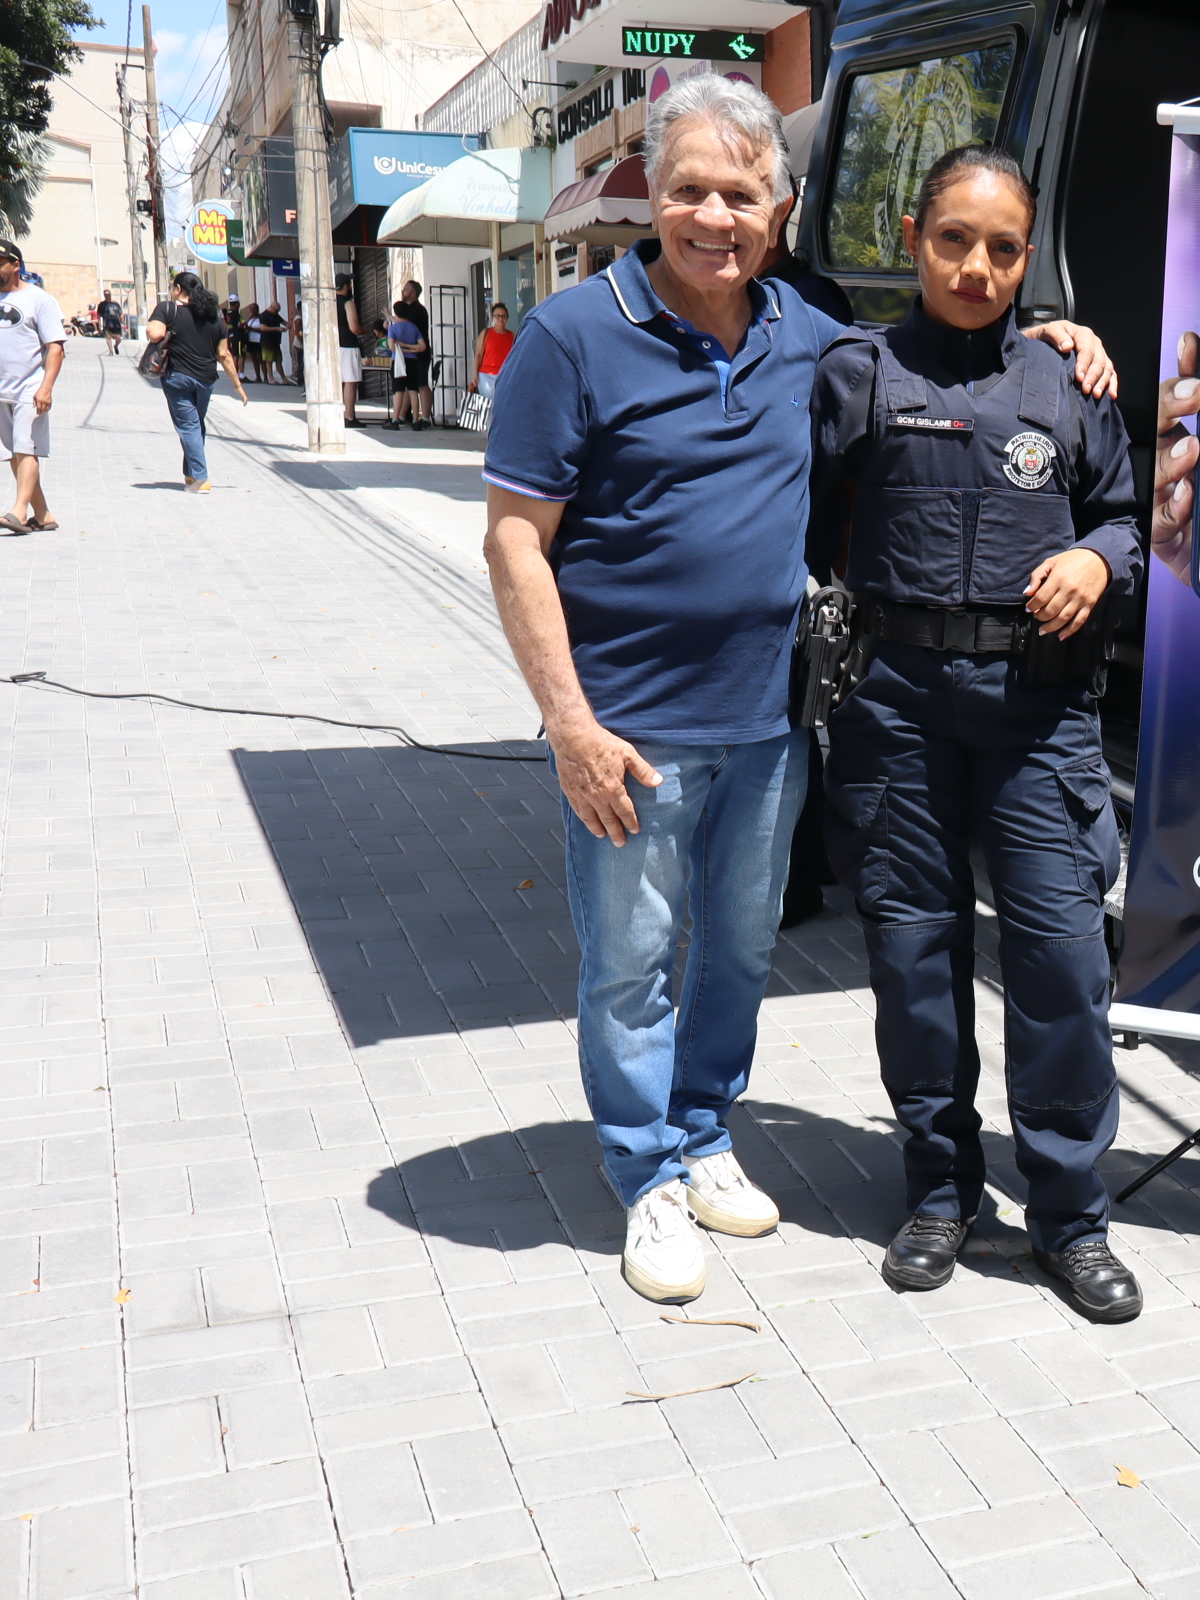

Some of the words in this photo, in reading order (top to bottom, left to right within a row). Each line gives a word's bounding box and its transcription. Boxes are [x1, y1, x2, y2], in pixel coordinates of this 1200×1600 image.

[625, 31, 696, 55] NUPY
[897, 416, 914, 424] GCM
[916, 418, 952, 427] GISLAINE
[1011, 434, 1053, 451] PATRULHEIRO
